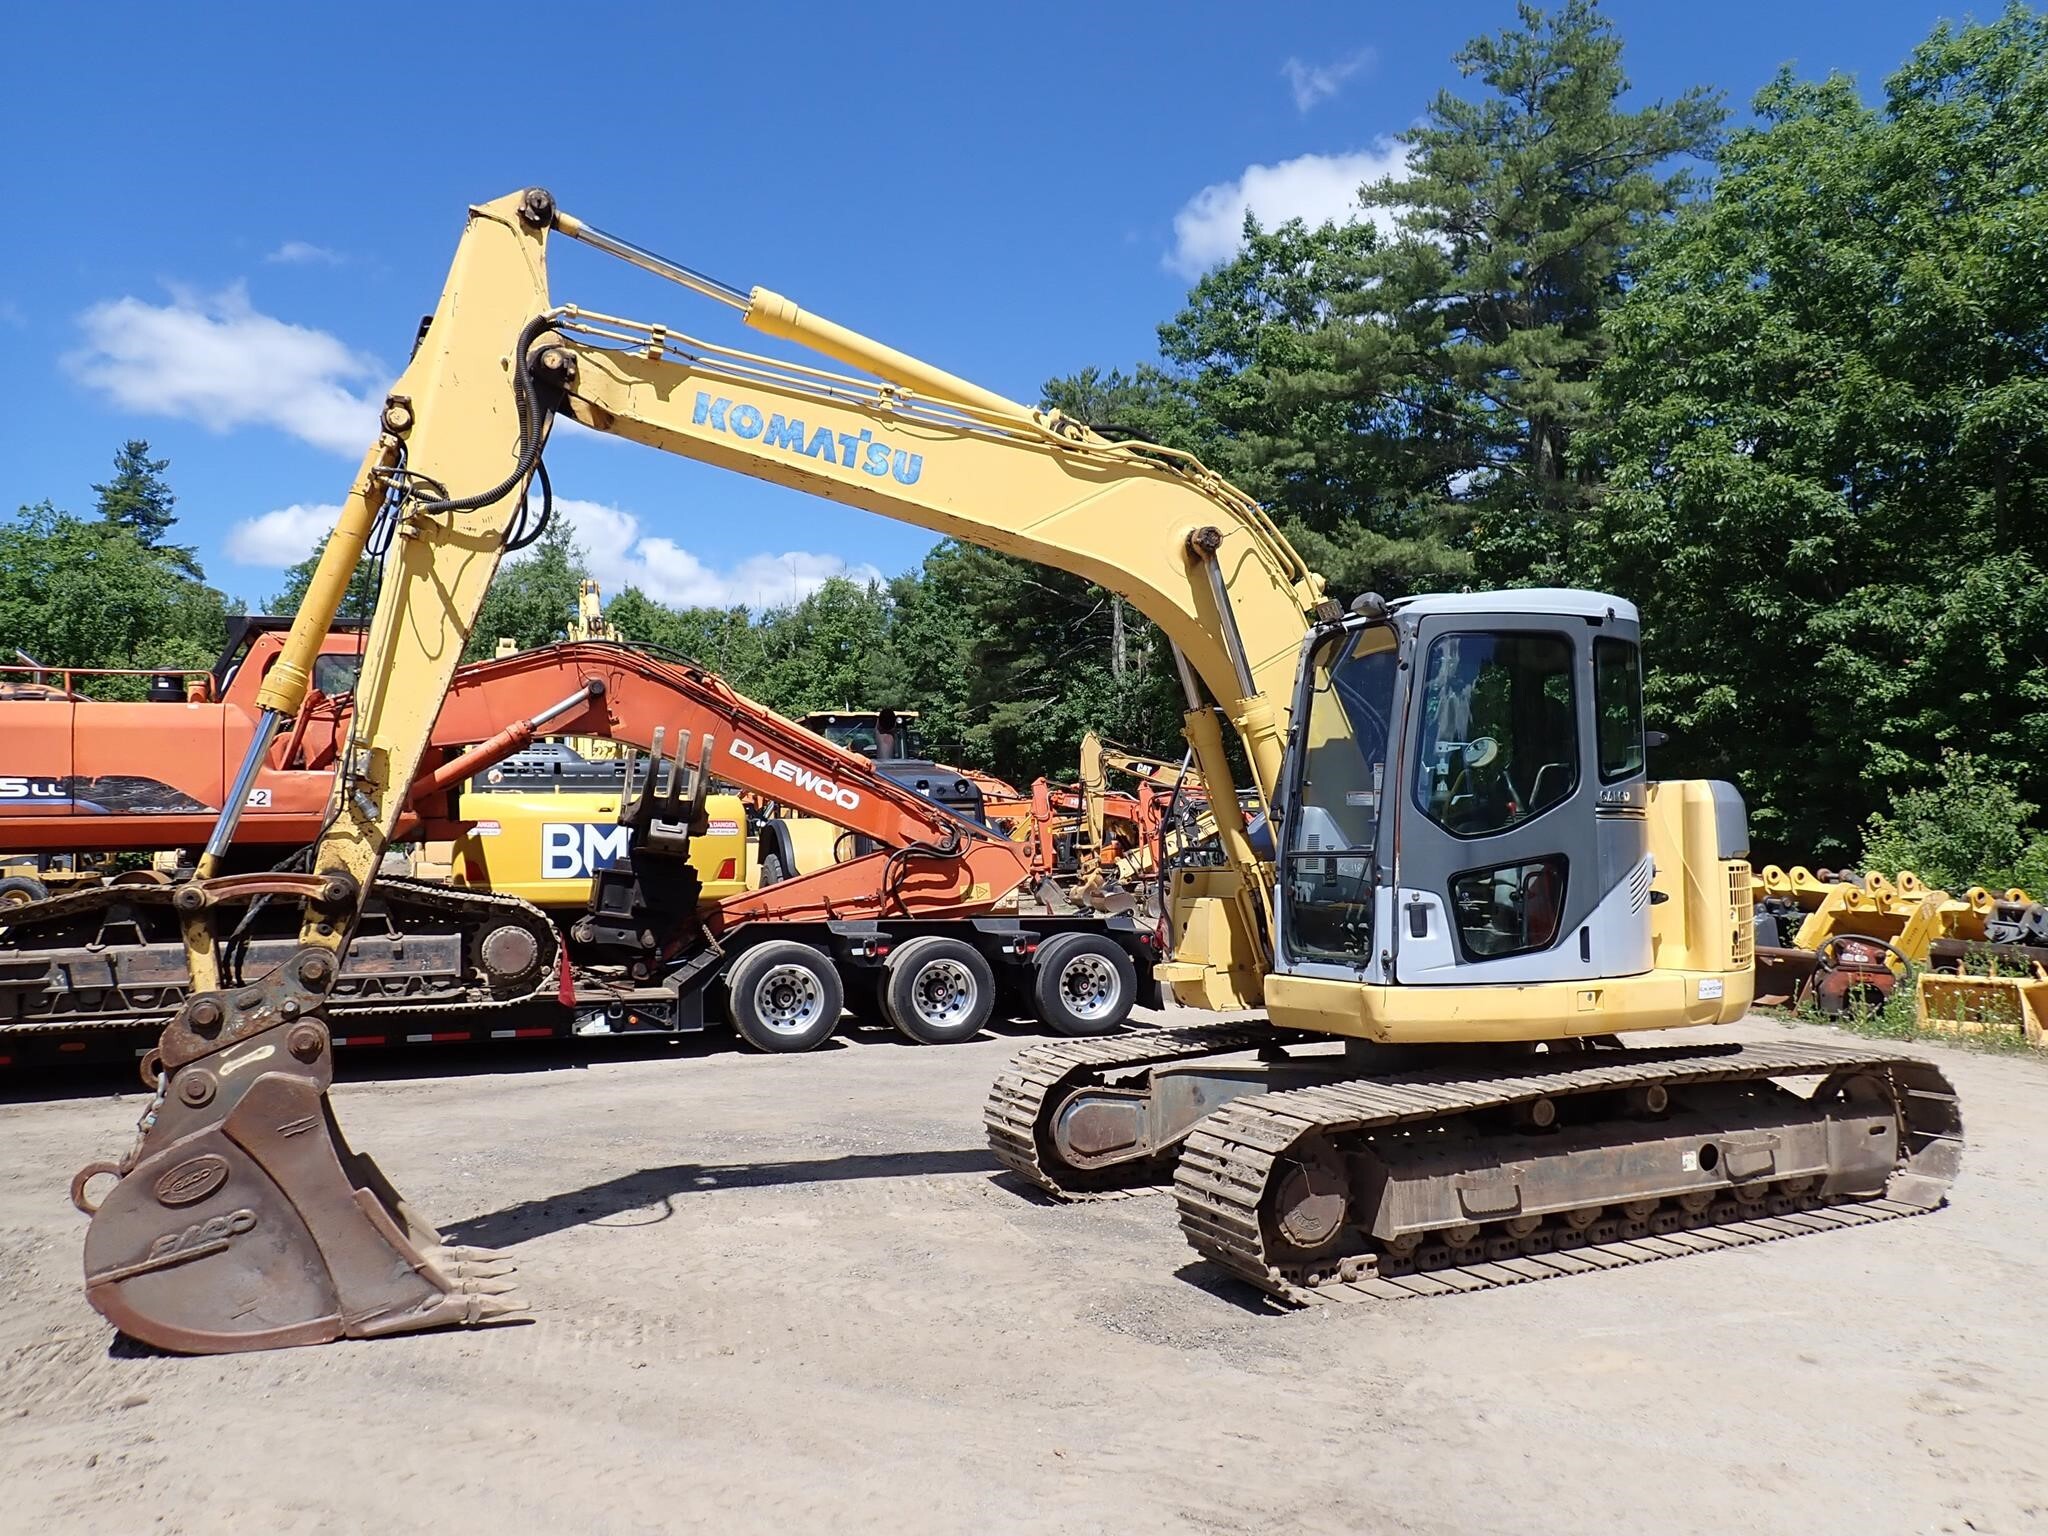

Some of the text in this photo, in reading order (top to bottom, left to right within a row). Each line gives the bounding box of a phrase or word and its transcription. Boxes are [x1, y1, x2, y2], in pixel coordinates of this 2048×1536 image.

[692, 391, 923, 486] KOMATSU
[728, 738, 860, 810] DAEWOO
[1136, 763, 1153, 776] CAT
